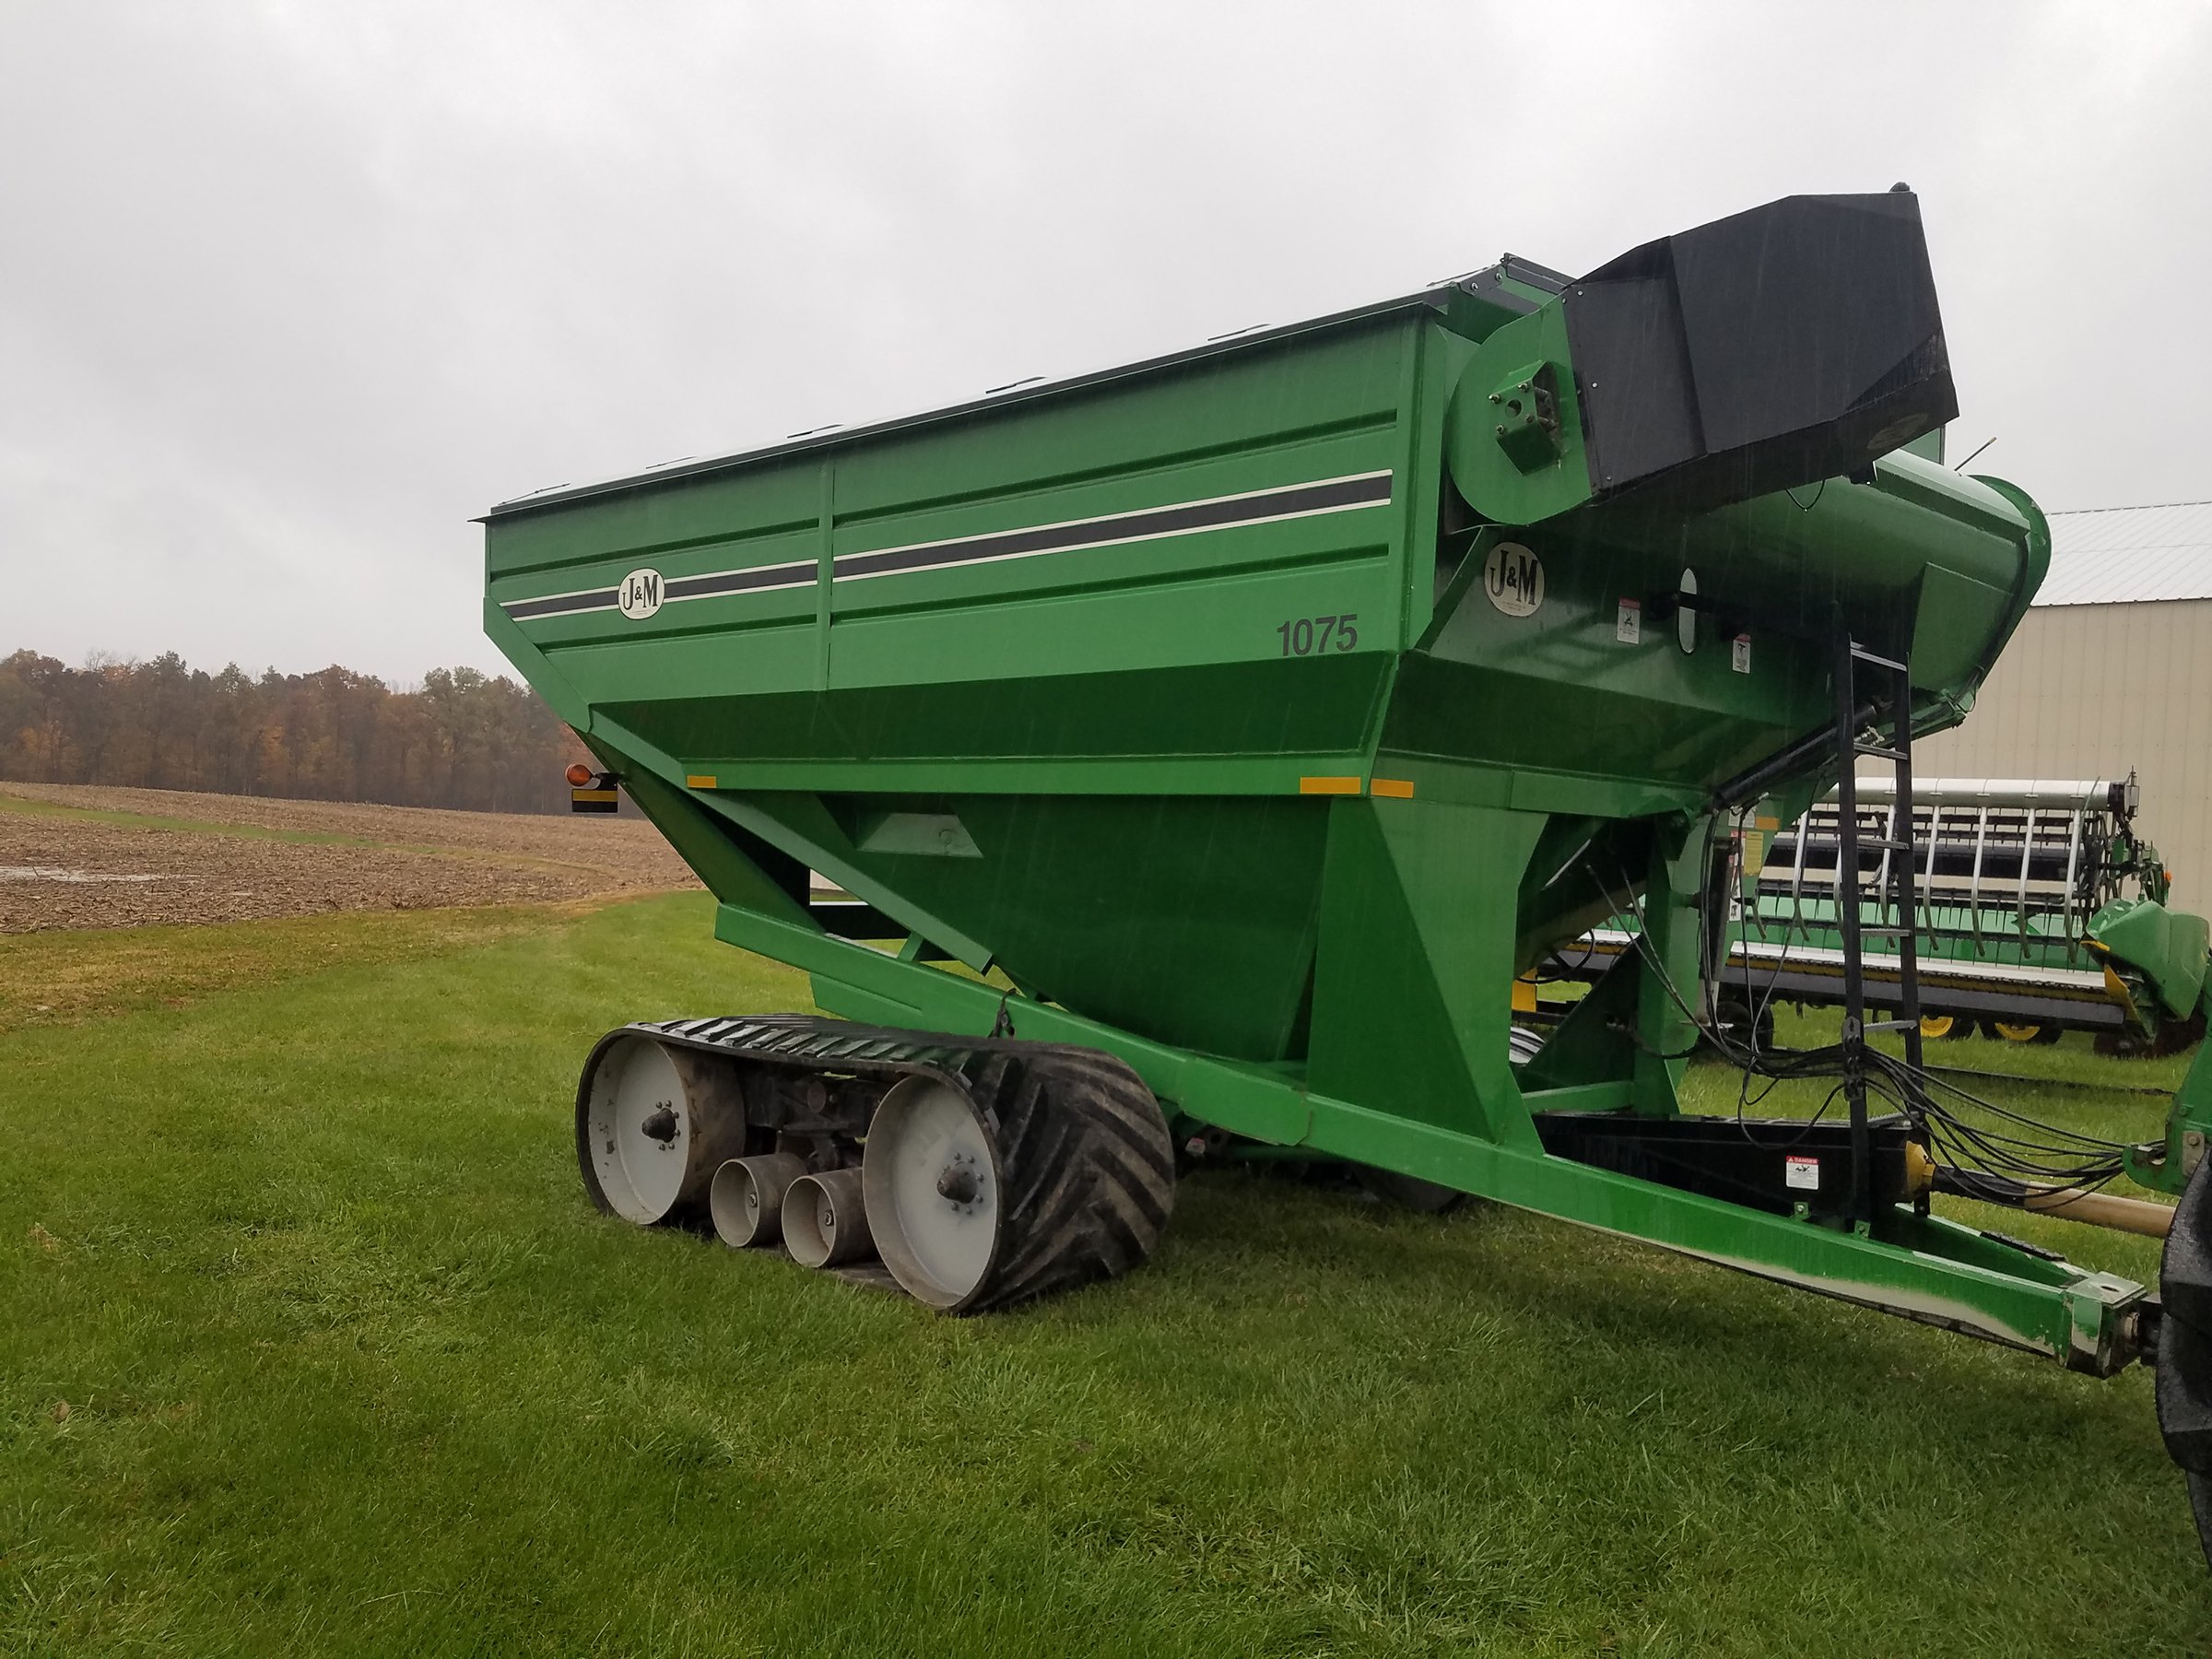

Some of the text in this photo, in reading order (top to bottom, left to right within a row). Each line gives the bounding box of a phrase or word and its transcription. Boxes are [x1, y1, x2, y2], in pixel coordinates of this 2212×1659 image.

[622, 574, 658, 610] J&M
[1489, 549, 1538, 606] J&M
[1277, 614, 1358, 656] 1075
